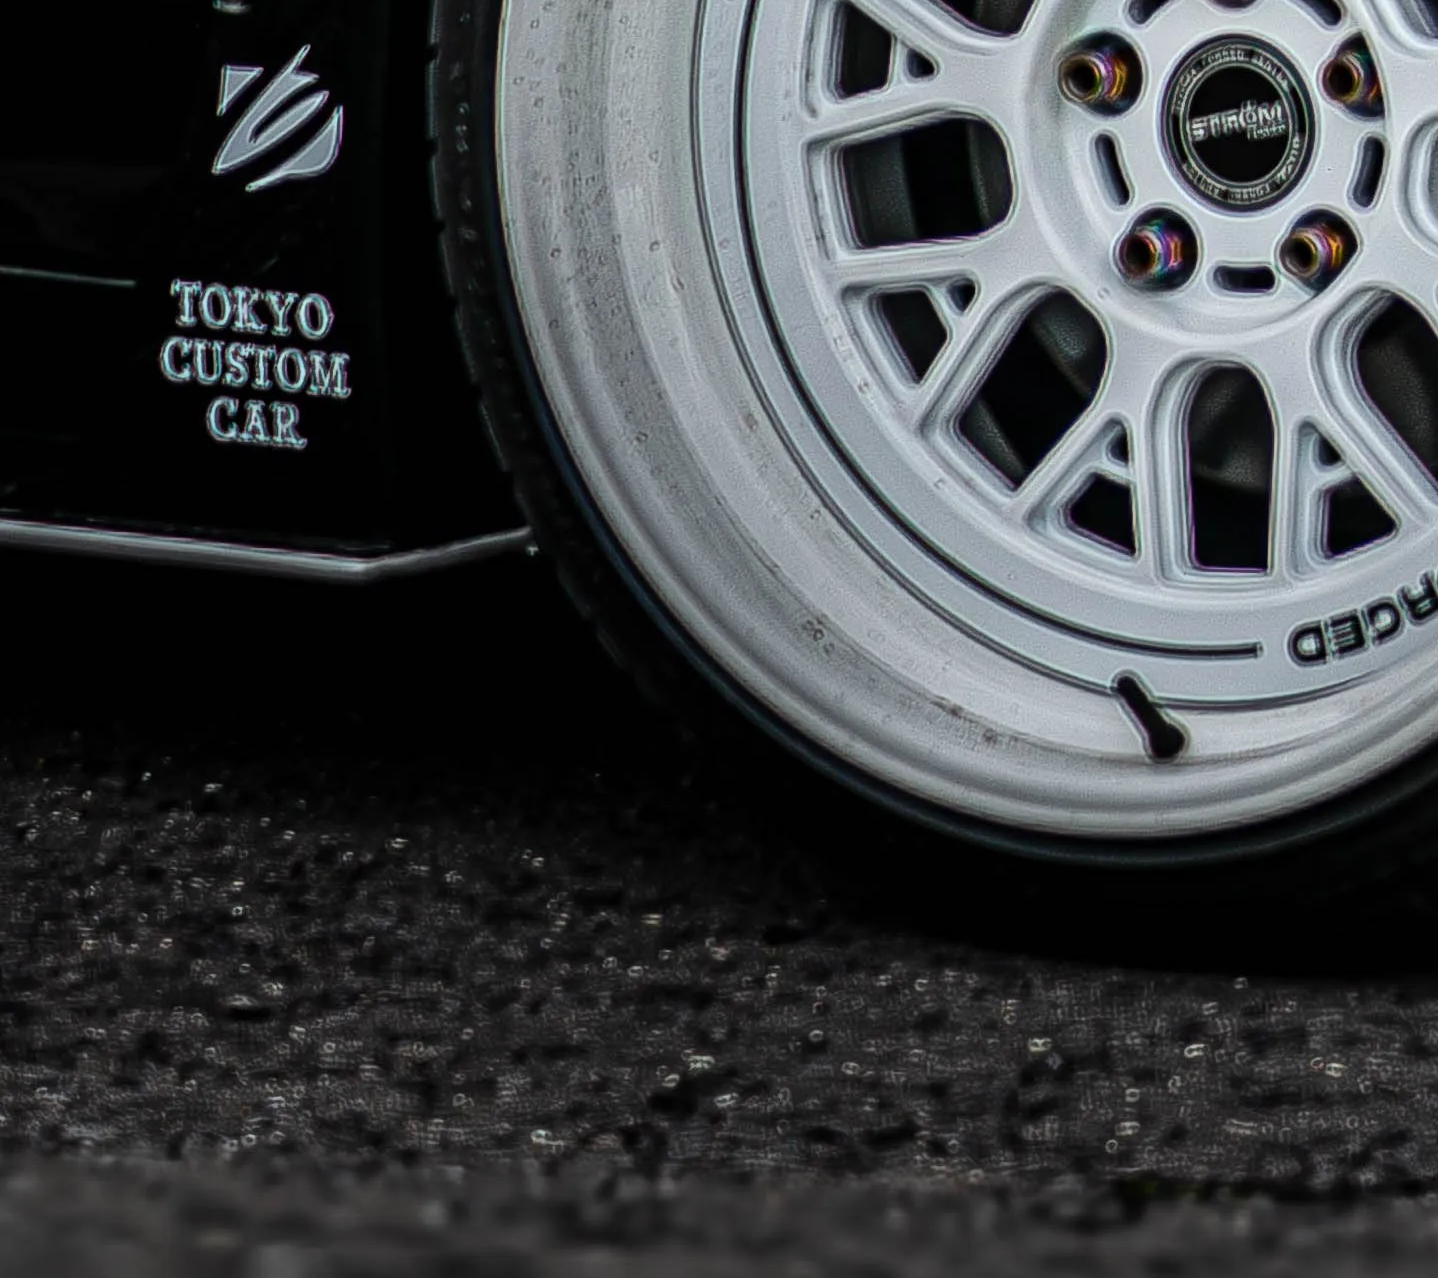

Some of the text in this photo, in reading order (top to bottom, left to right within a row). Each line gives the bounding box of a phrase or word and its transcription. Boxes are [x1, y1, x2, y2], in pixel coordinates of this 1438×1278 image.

[170, 279, 334, 339] TOKYO
[159, 336, 353, 400] CUSTOM
[206, 396, 309, 451] CAR
